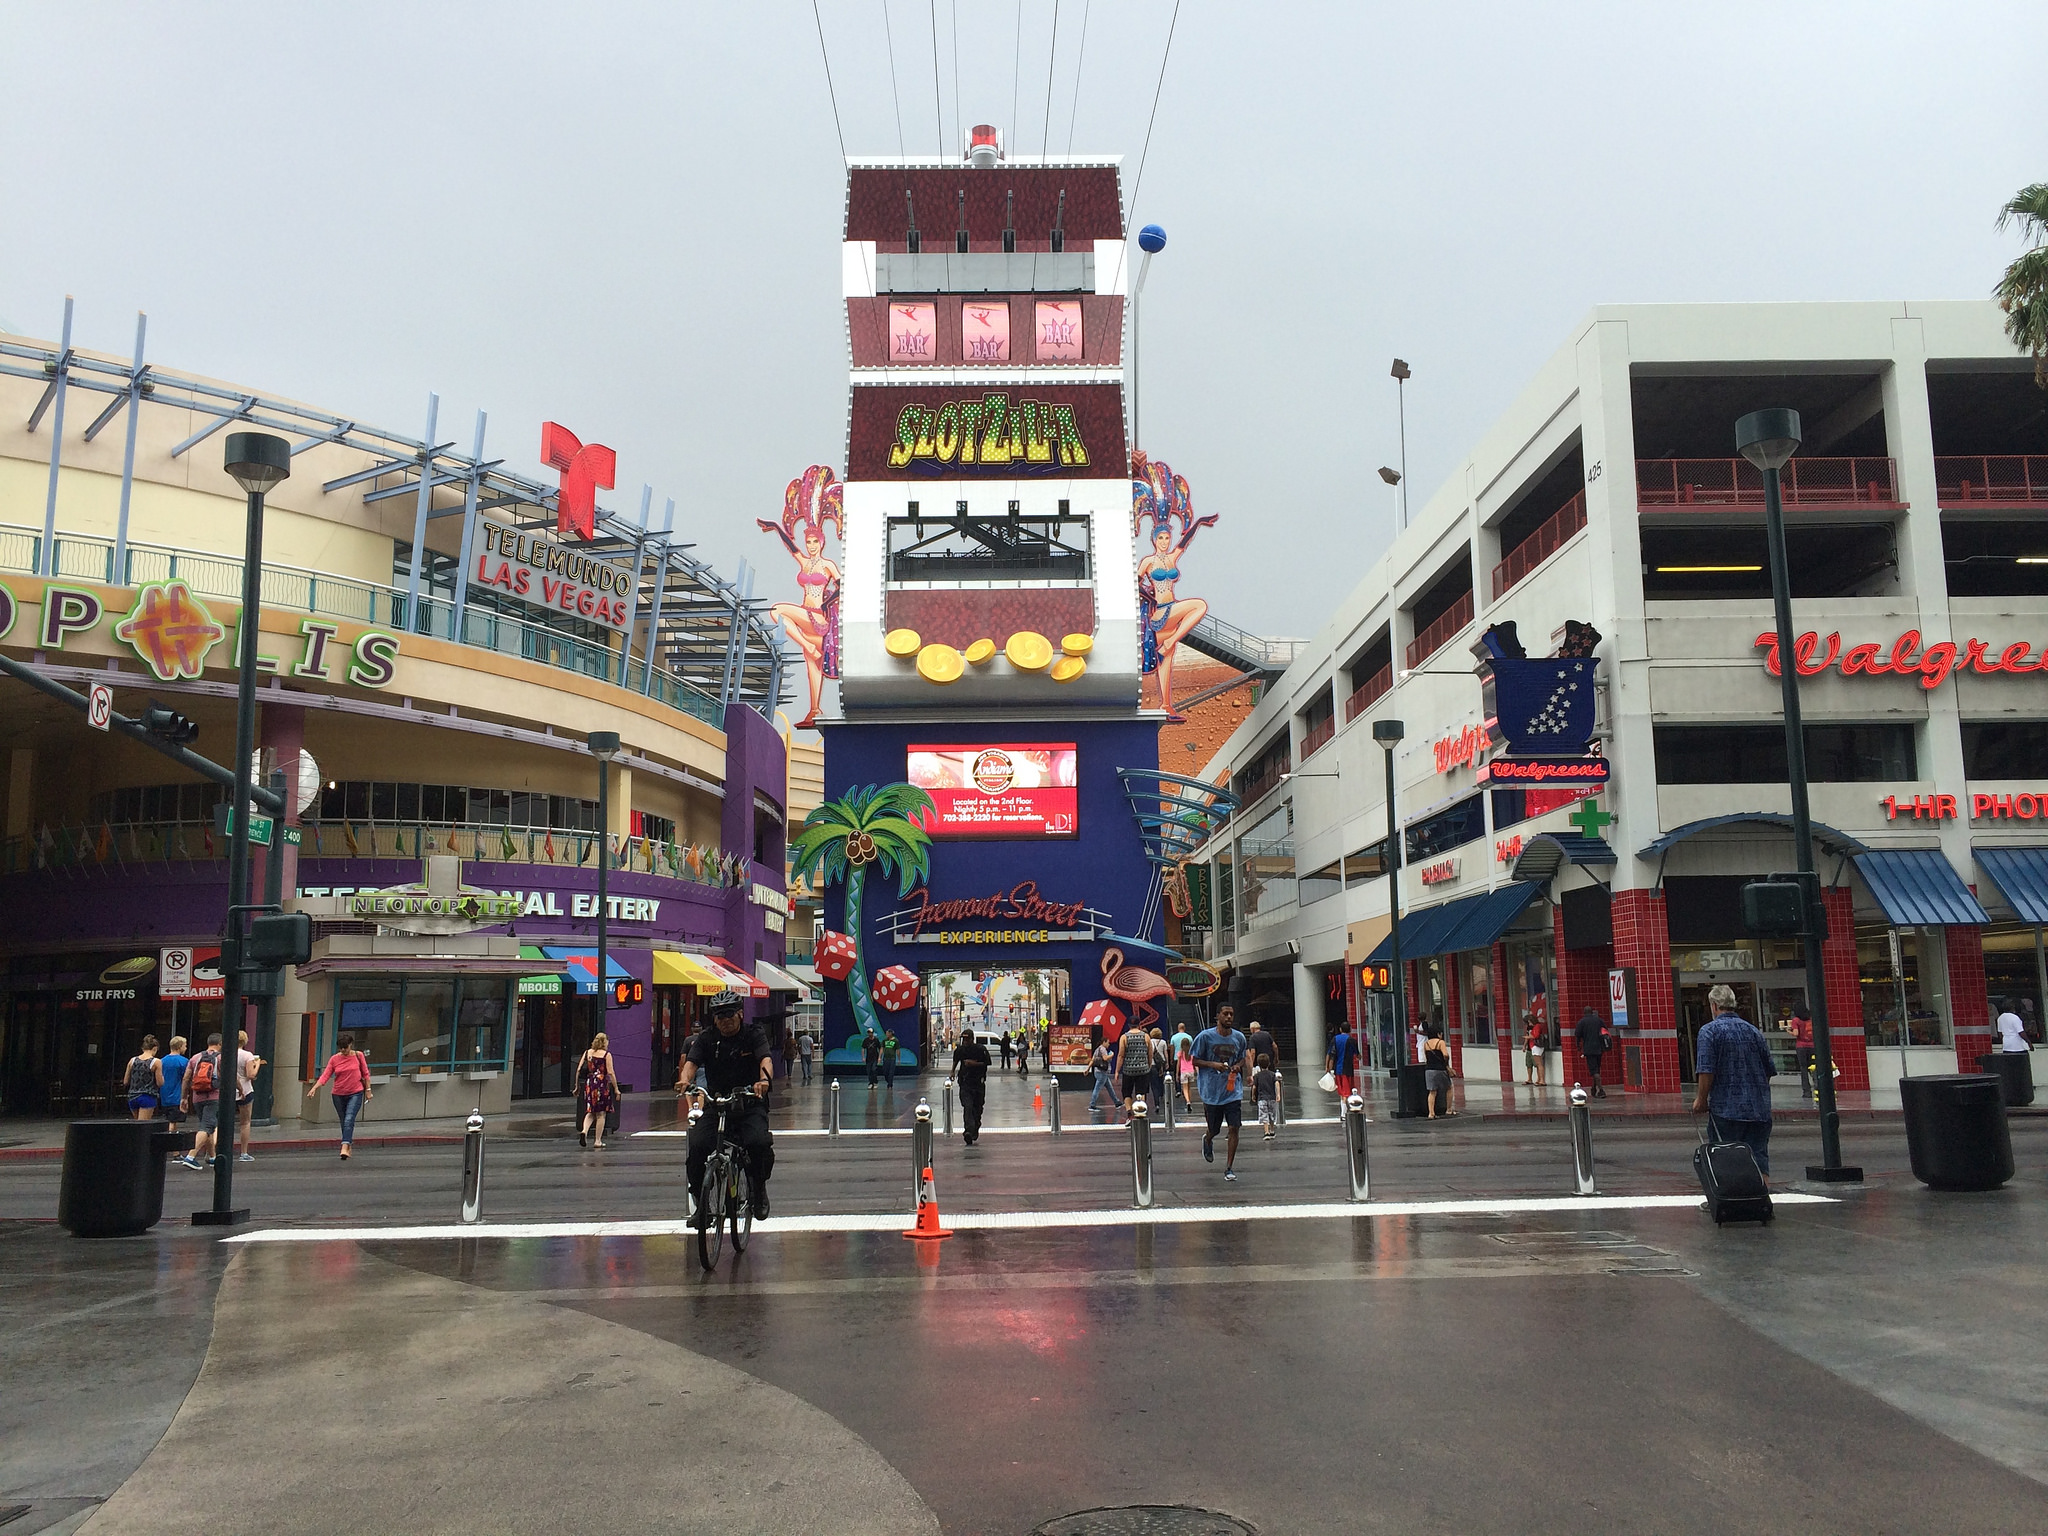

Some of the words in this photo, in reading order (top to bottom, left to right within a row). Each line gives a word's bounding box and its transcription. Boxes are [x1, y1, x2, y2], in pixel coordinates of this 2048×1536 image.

[1044, 325, 1071, 344] BAR
[899, 335, 925, 354] BAR
[973, 341, 999, 358] BAR
[887, 391, 1091, 468] SLOTZILLA
[1588, 460, 1602, 483] 425
[484, 522, 632, 597] TELEMUNDO
[478, 555, 531, 594] LAS
[543, 576, 627, 626] VEGAS
[1754, 629, 2048, 689] Walgre
[1490, 762, 1607, 780] Walgreens
[952, 797, 978, 805] Located
[989, 797, 1000, 805] the
[1001, 797, 1014, 805] 2nd
[1016, 797, 1034, 805] Floor.
[953, 805, 978, 814] Nightly
[979, 805, 984, 813] 5
[1884, 793, 1958, 819] 1-HR
[288, 831, 301, 843] 400
[1198, 868, 1209, 923] BRASS
[901, 886, 1003, 941] Fremont
[1003, 879, 1084, 927] Street
[939, 929, 1049, 945] EXPERIENCE
[76, 990, 103, 1000] STIR
[106, 989, 136, 999] FRYS
[181, 987, 225, 997] AMEN
